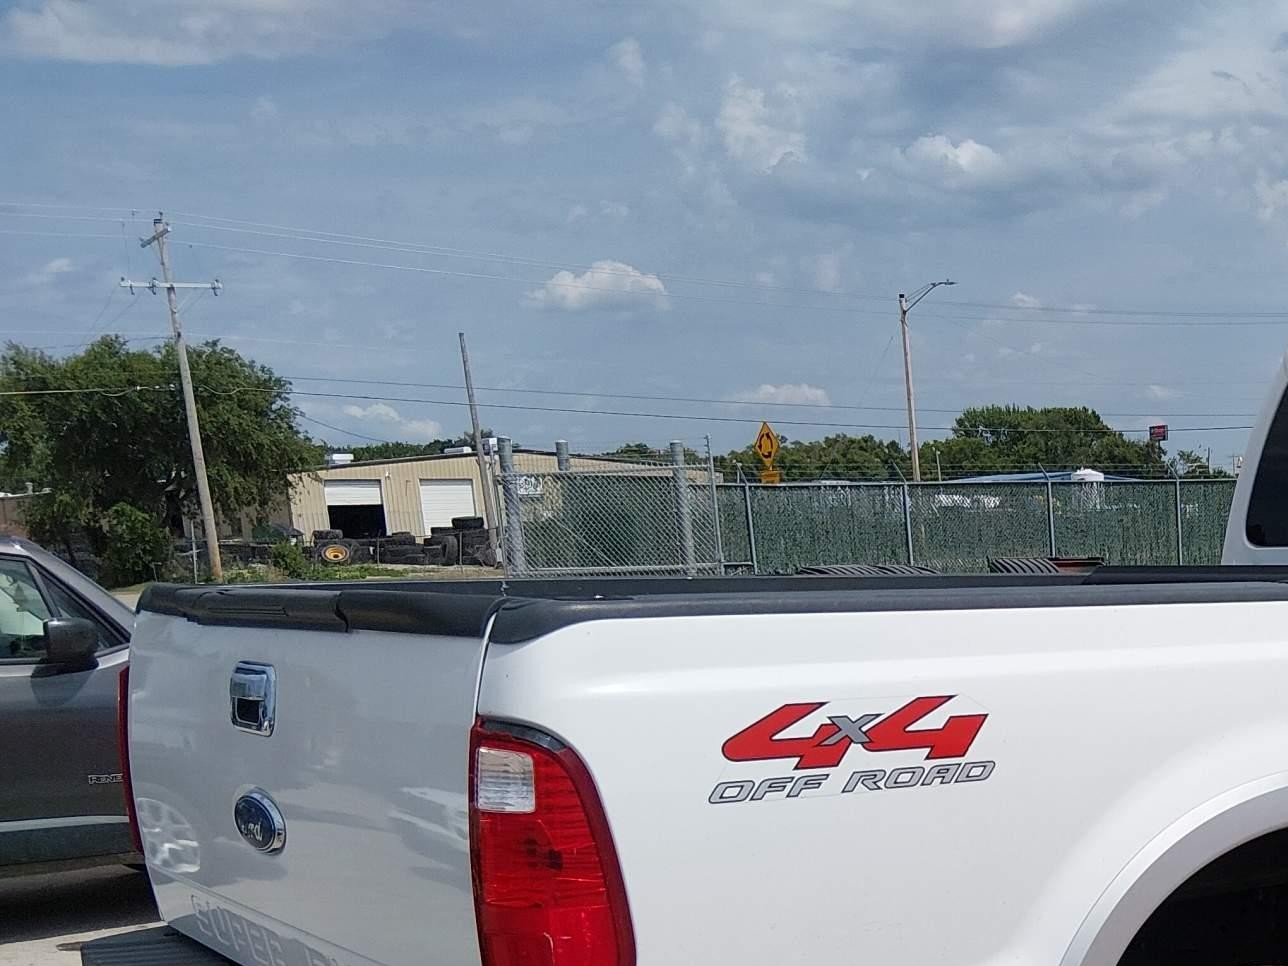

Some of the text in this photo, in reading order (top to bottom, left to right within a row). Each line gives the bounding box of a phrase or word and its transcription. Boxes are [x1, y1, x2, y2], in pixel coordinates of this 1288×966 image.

[88, 774, 123, 784] RENE
[709, 760, 996, 804] OFF ROAD
